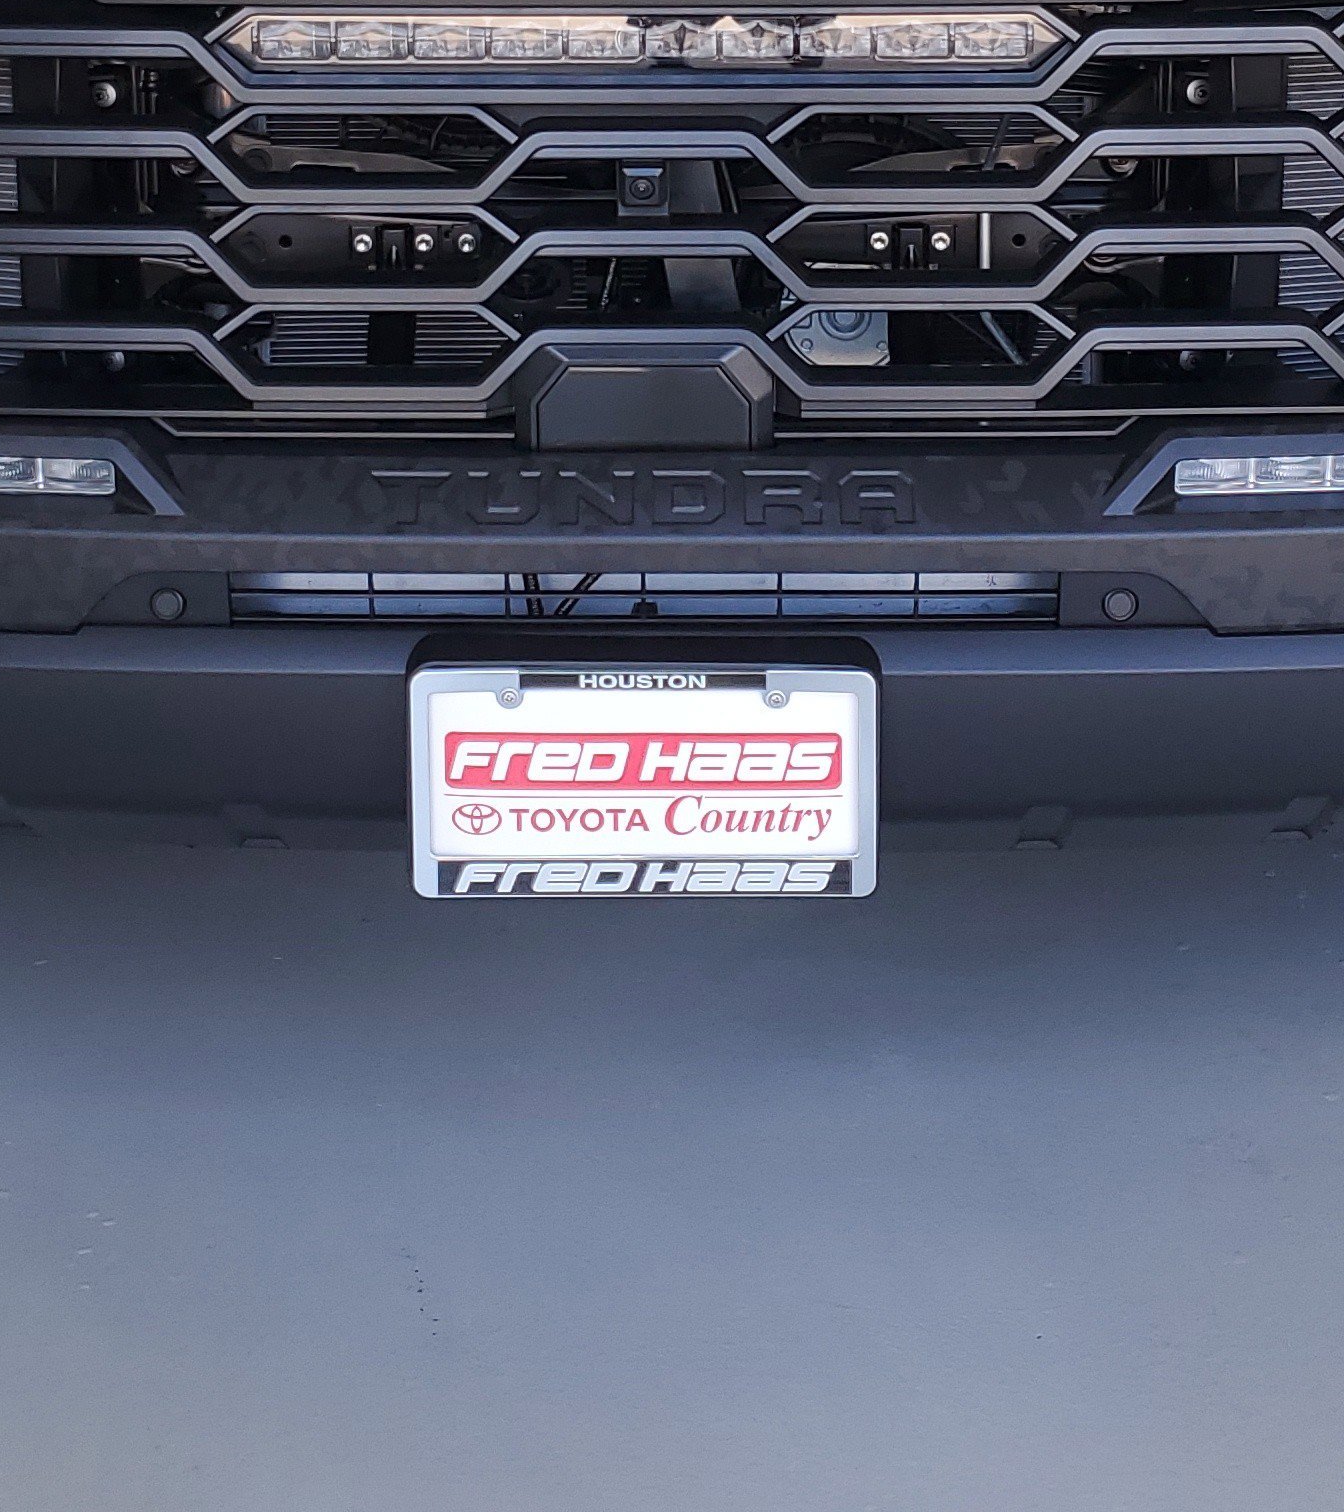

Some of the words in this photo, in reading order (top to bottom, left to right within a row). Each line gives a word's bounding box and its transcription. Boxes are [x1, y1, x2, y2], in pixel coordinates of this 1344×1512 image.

[370, 469, 917, 526] TUNDRA
[579, 674, 706, 690] HOUSTON
[509, 808, 650, 833] TOYOTA
[664, 795, 832, 841] Country
